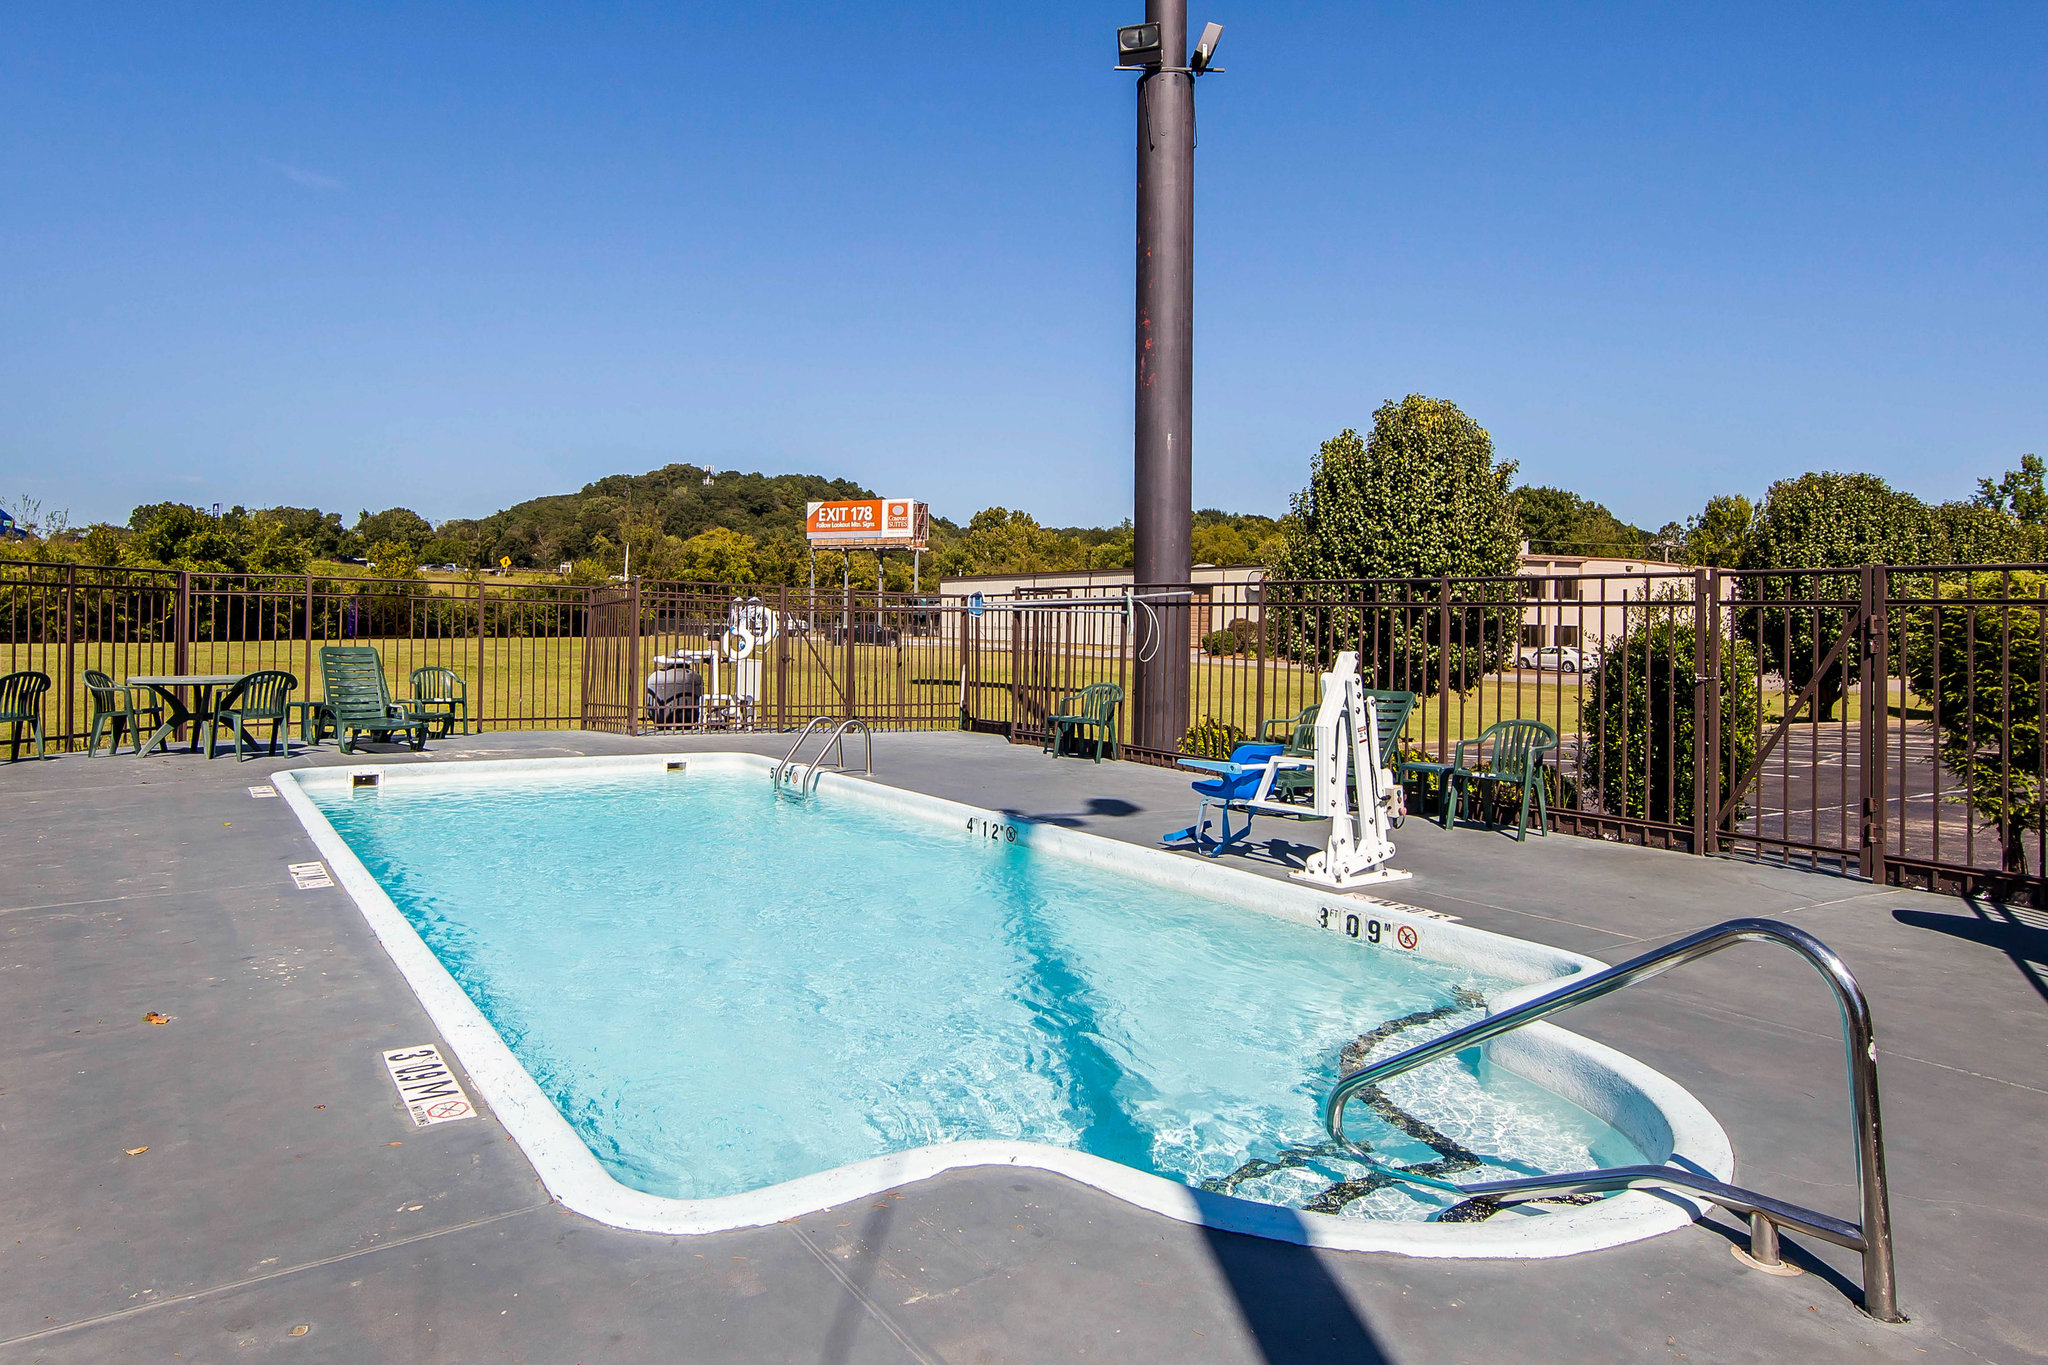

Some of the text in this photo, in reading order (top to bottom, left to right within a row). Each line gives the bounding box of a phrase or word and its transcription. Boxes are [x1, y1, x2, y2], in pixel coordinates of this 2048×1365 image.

[818, 507, 849, 522] EXIT
[850, 506, 873, 521] 178
[862, 521, 875, 529] Signs
